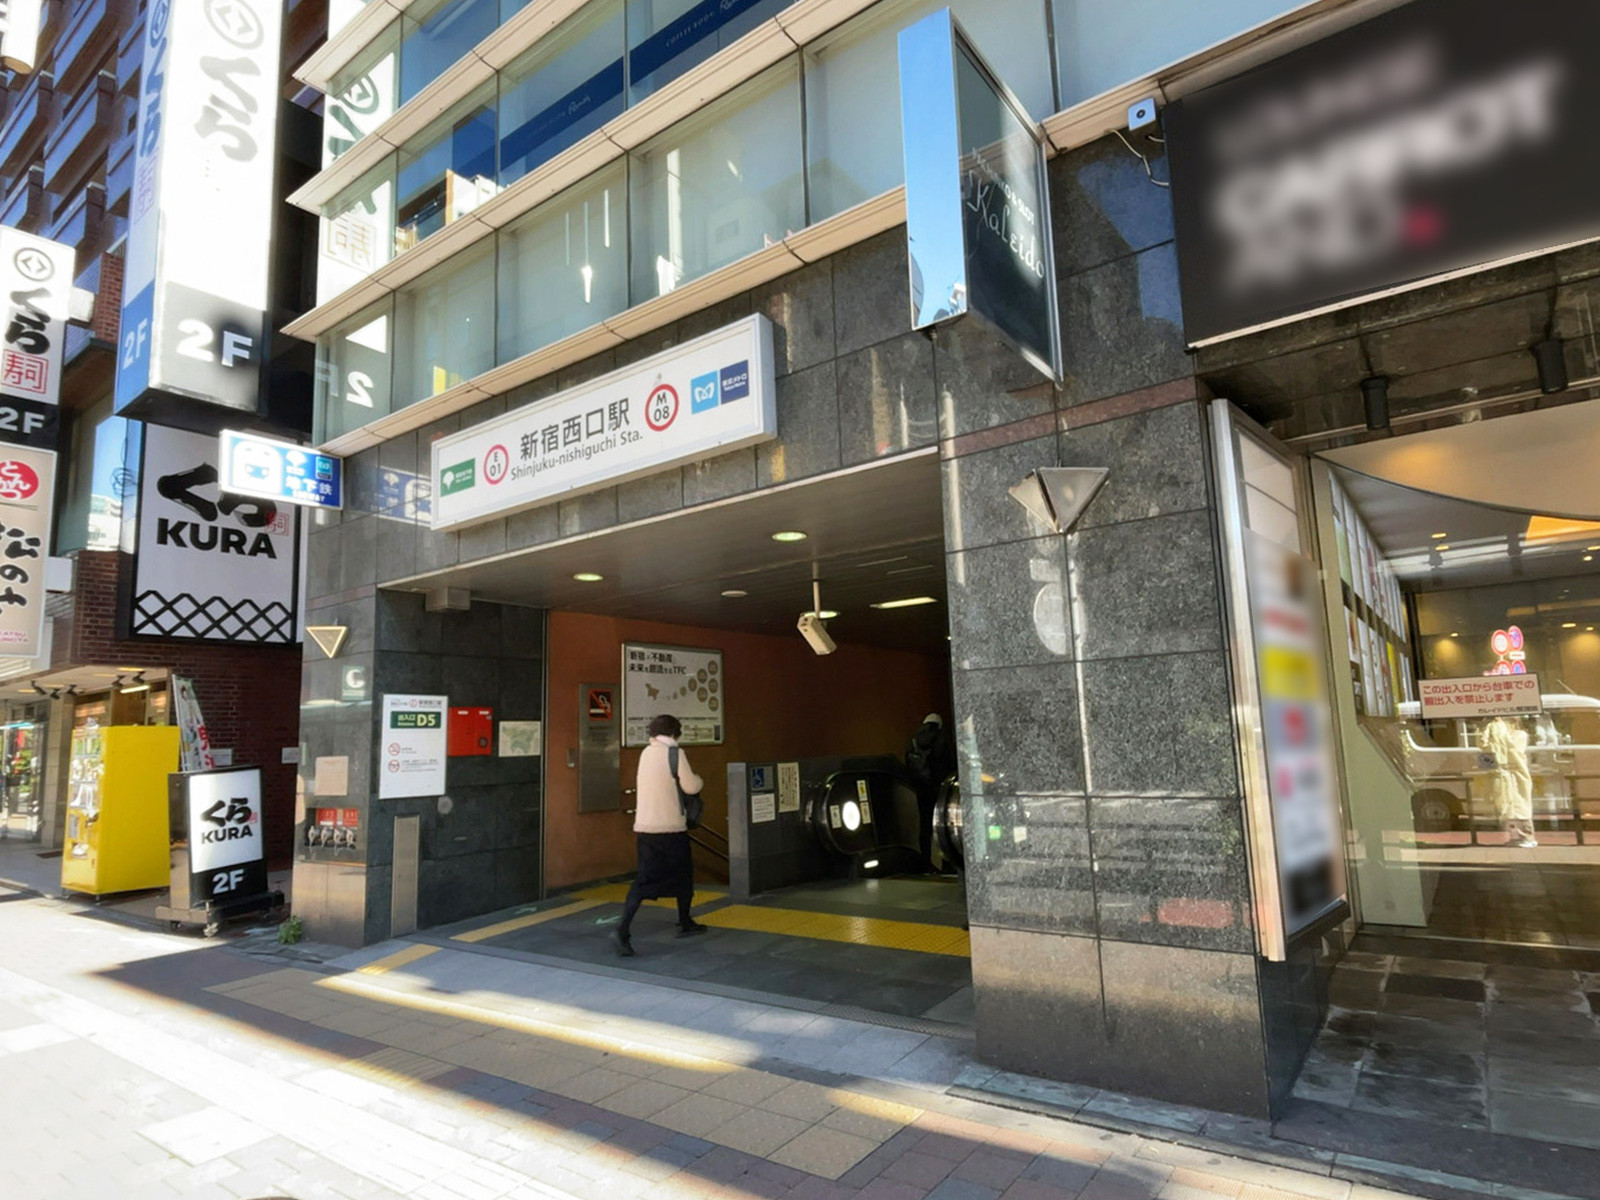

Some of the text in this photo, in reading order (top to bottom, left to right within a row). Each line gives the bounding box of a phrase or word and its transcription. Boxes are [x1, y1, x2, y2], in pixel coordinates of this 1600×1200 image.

[5, 287, 52, 355] くら
[122, 318, 148, 369] 2F
[176, 318, 253, 368] 2F
[4, 353, 44, 391] 寿司
[656, 393, 667, 405] M
[0, 406, 46, 434] 2F
[653, 407, 670, 422] 08
[519, 397, 631, 462] 新宿西口駅
[493, 451, 499, 463] E
[510, 429, 644, 482] Shinjuku-nishiguchi Sta.
[489, 463, 502, 477] 01
[157, 518, 277, 560] KURA
[1423, 680, 1535, 695] この出入口から台車での
[417, 713, 436, 727] D5
[200, 797, 252, 828] くら
[201, 824, 253, 845] KURA
[212, 868, 244, 895] 2F
